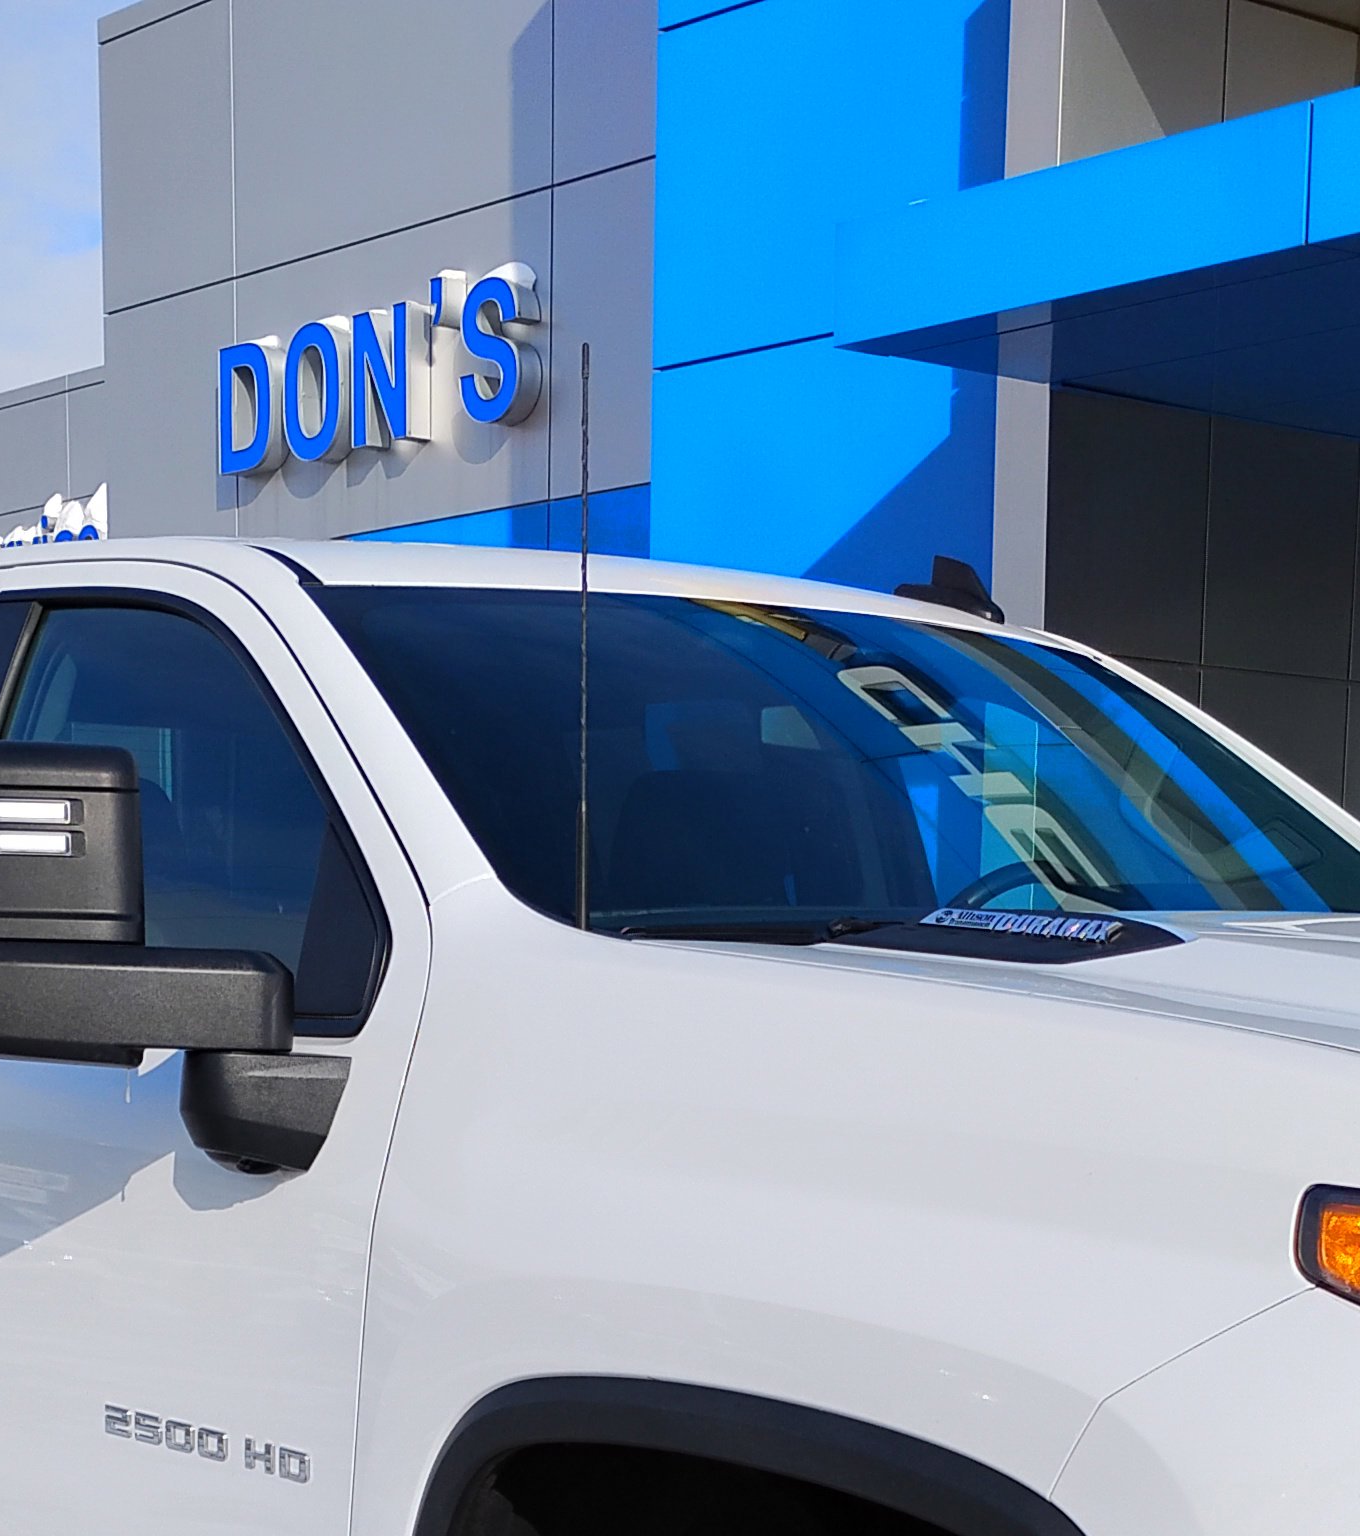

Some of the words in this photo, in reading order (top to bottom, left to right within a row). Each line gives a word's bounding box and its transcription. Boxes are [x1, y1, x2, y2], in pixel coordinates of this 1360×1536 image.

[219, 273, 536, 476] DON'S
[104, 1401, 229, 1462] 2500
[244, 1435, 311, 1484] HD
